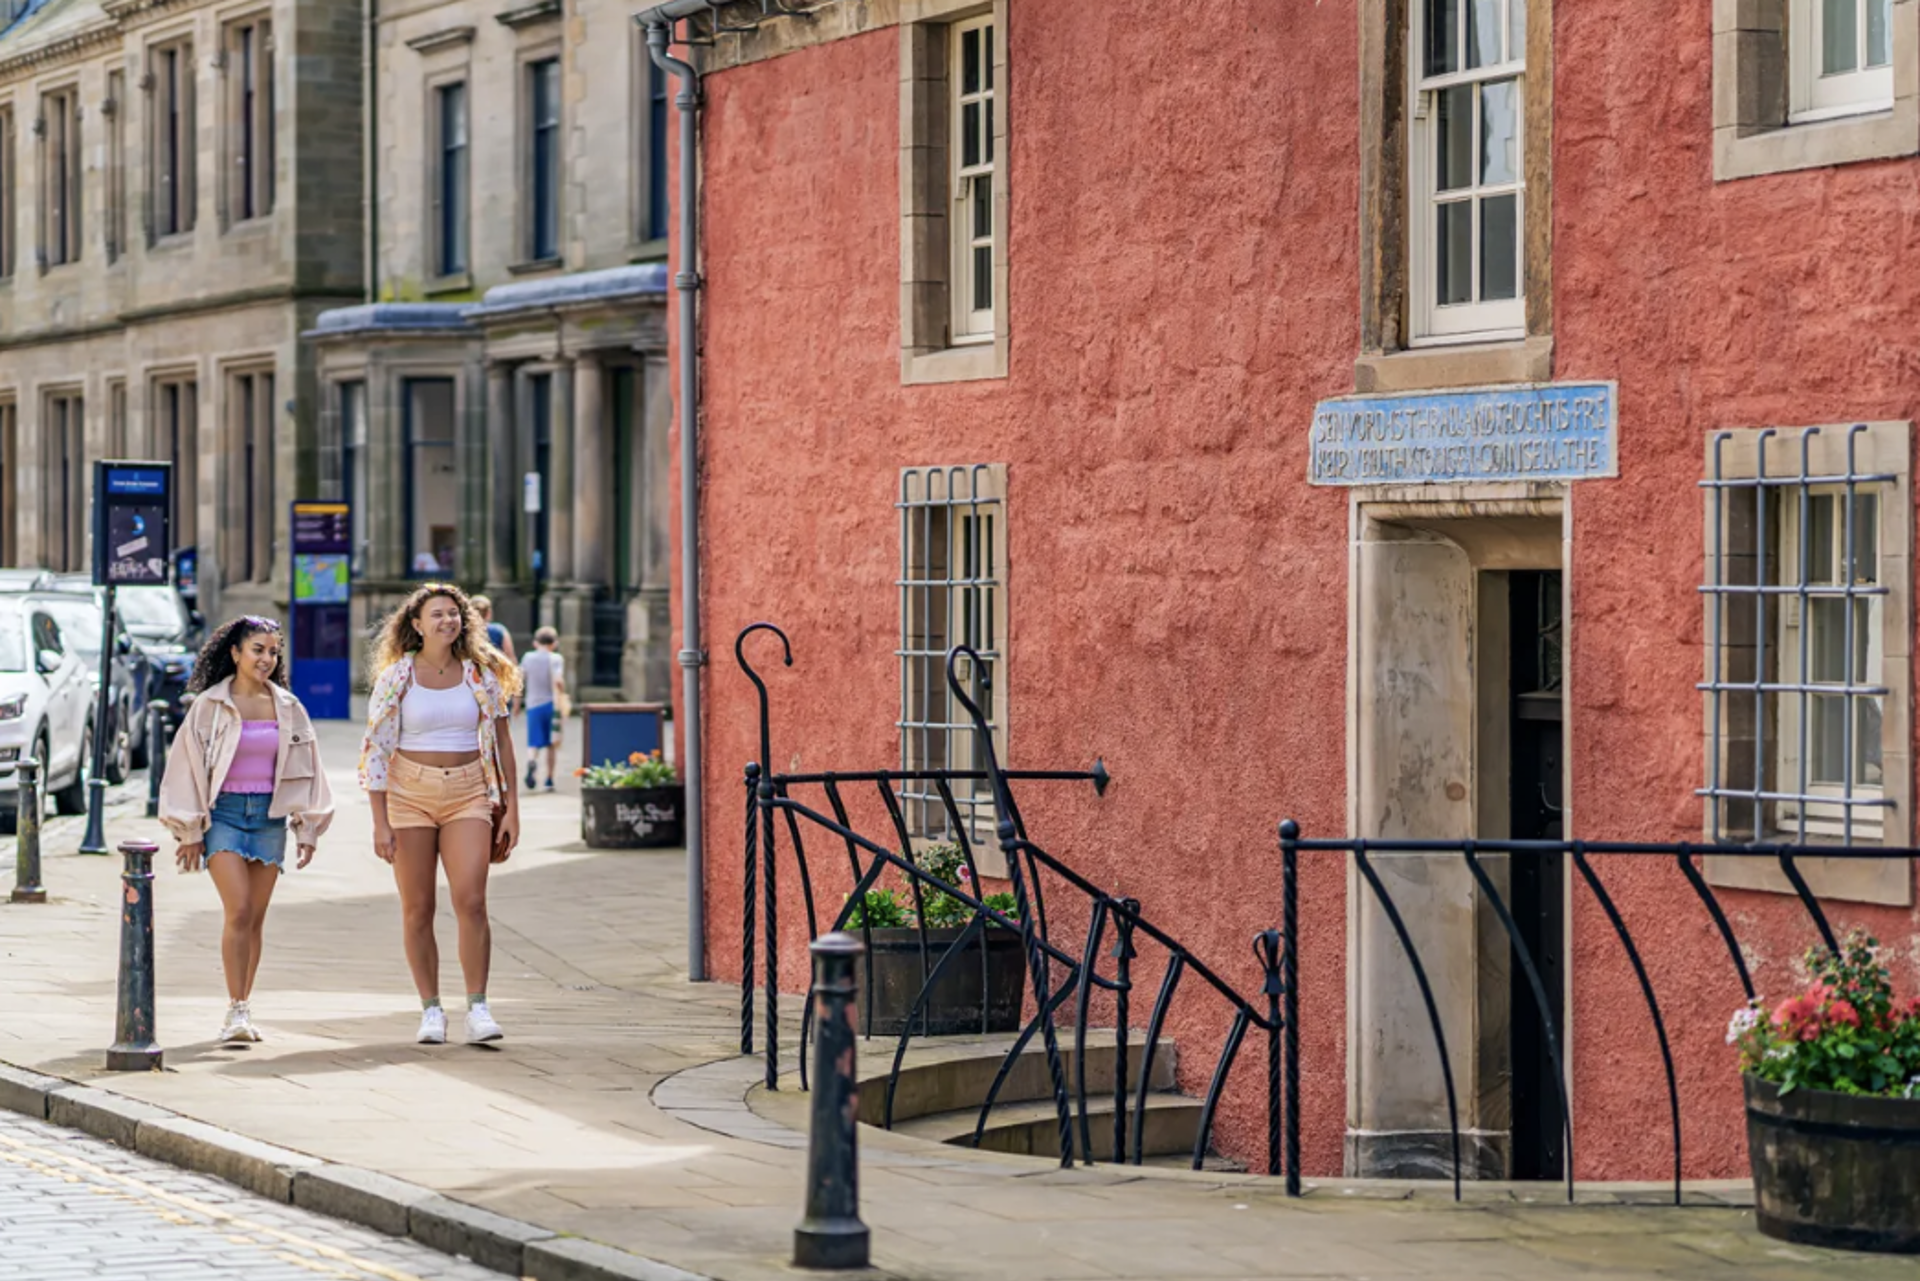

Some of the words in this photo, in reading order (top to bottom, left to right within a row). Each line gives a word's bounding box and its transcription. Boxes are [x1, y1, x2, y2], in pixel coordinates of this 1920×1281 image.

[1316, 411, 1343, 443] SEN
[1390, 409, 1405, 441] IS
[1555, 397, 1570, 432] IS
[1572, 393, 1607, 431] FRE
